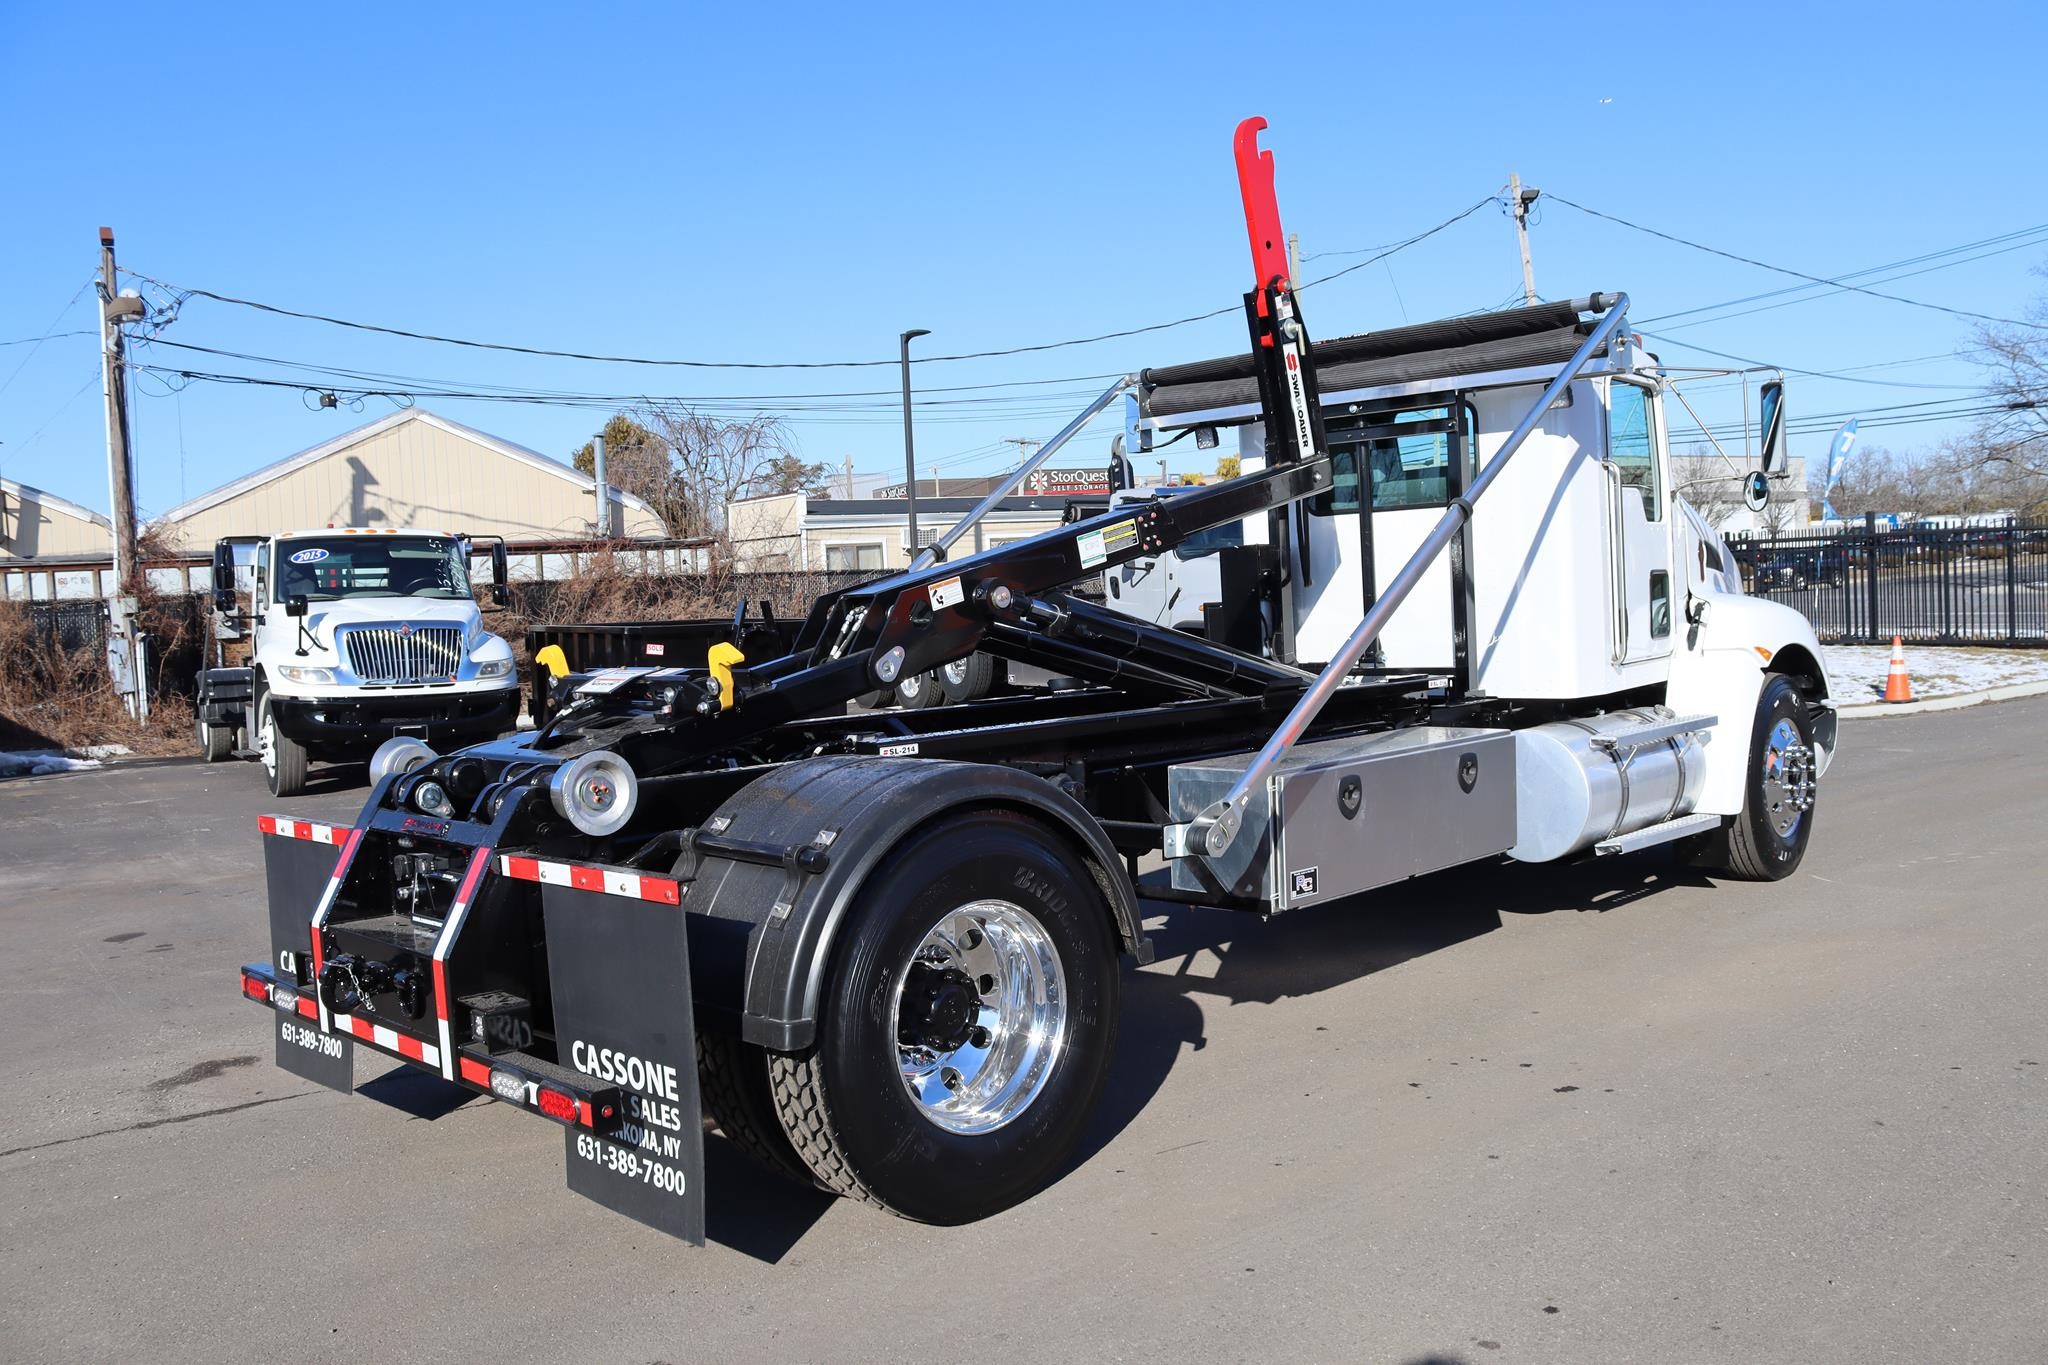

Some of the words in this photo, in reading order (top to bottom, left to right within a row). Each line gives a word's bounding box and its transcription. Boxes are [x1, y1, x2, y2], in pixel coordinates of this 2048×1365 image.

[1051, 470, 1109, 484] StorQuest
[298, 551, 321, 561] 2015
[282, 1022, 342, 1059] 631-389-7800
[572, 1040, 679, 1102] CASSONE
[631, 1095, 681, 1132] SALES
[577, 1134, 685, 1196] 631-389-7800
[664, 1135, 681, 1159] NY
